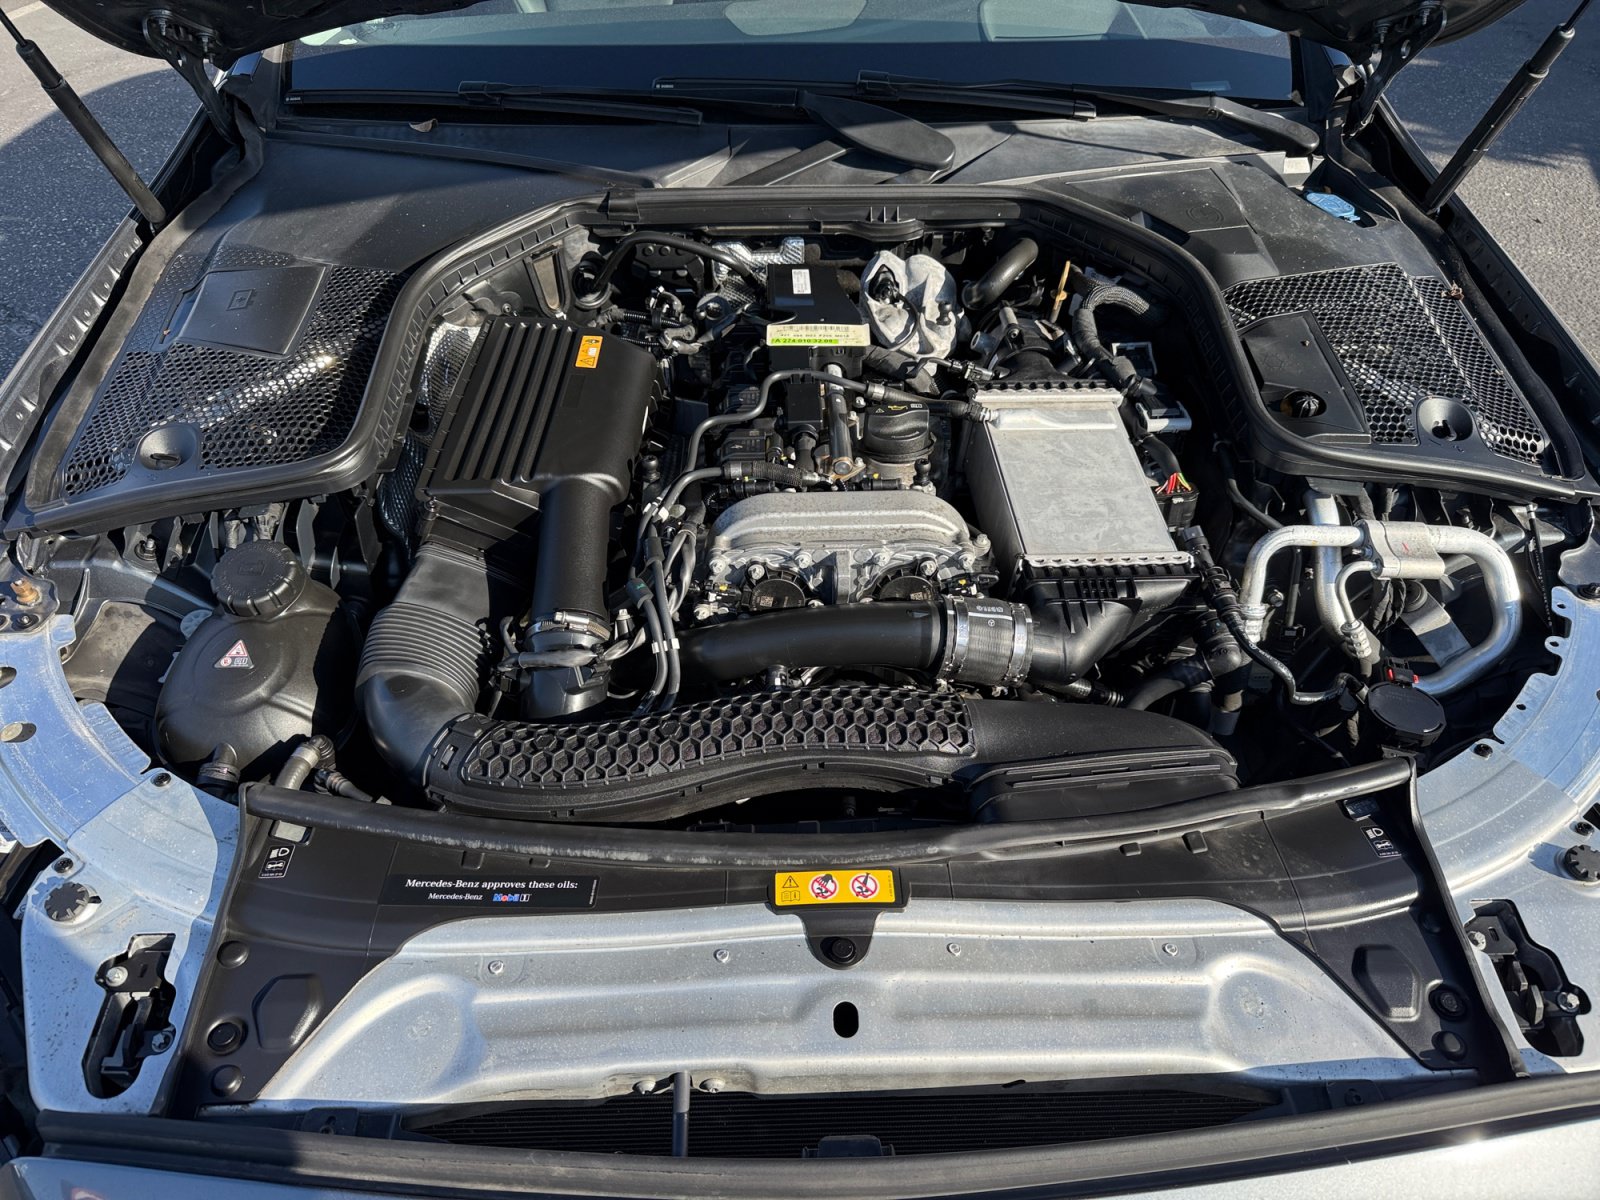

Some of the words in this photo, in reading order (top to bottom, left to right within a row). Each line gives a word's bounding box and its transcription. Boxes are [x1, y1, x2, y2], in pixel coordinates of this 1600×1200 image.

[405, 879, 480, 889] Mercedes-Benz
[481, 881, 526, 890] approves
[528, 880, 555, 889] these
[557, 881, 579, 889] oils:
[428, 892, 483, 900] Mercedes-Benz
[492, 893, 519, 902] Mobil
